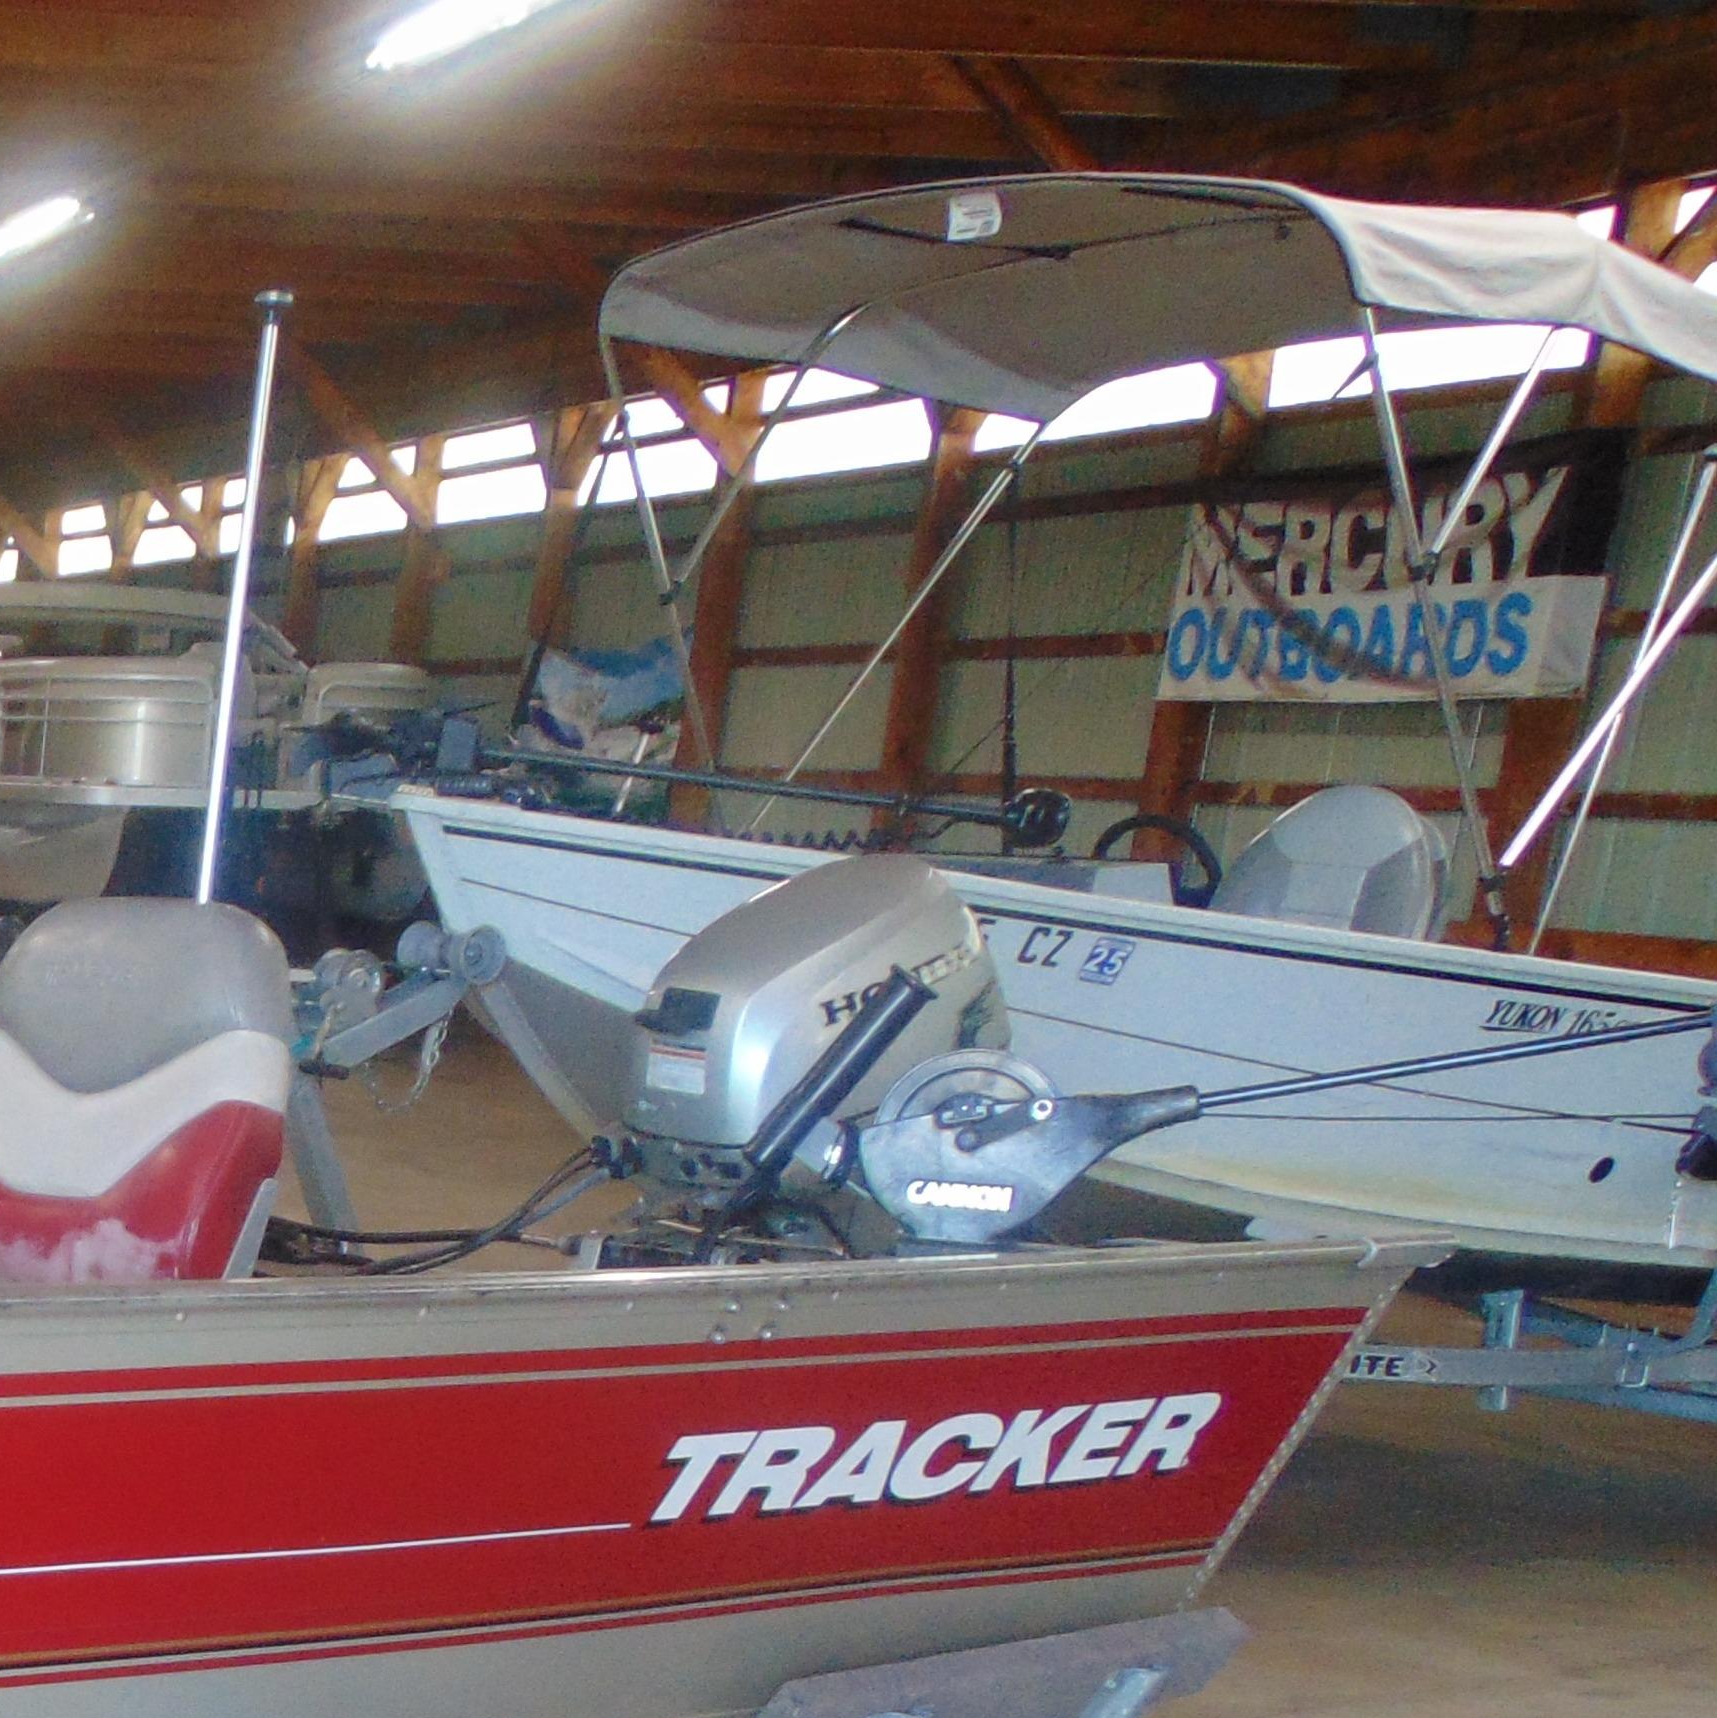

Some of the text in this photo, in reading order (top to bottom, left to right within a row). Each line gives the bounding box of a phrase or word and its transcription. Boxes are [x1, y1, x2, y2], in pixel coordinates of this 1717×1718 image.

[1177, 466, 1570, 597] MERCURY
[1167, 592, 1533, 683] OUTBOARDS
[1017, 926, 1074, 968] CZ
[1082, 945, 1128, 976] 25
[1485, 1000, 1567, 1032] YUKON
[1349, 1354, 1405, 1377] ITE
[649, 1392, 1222, 1523] TRACKER
